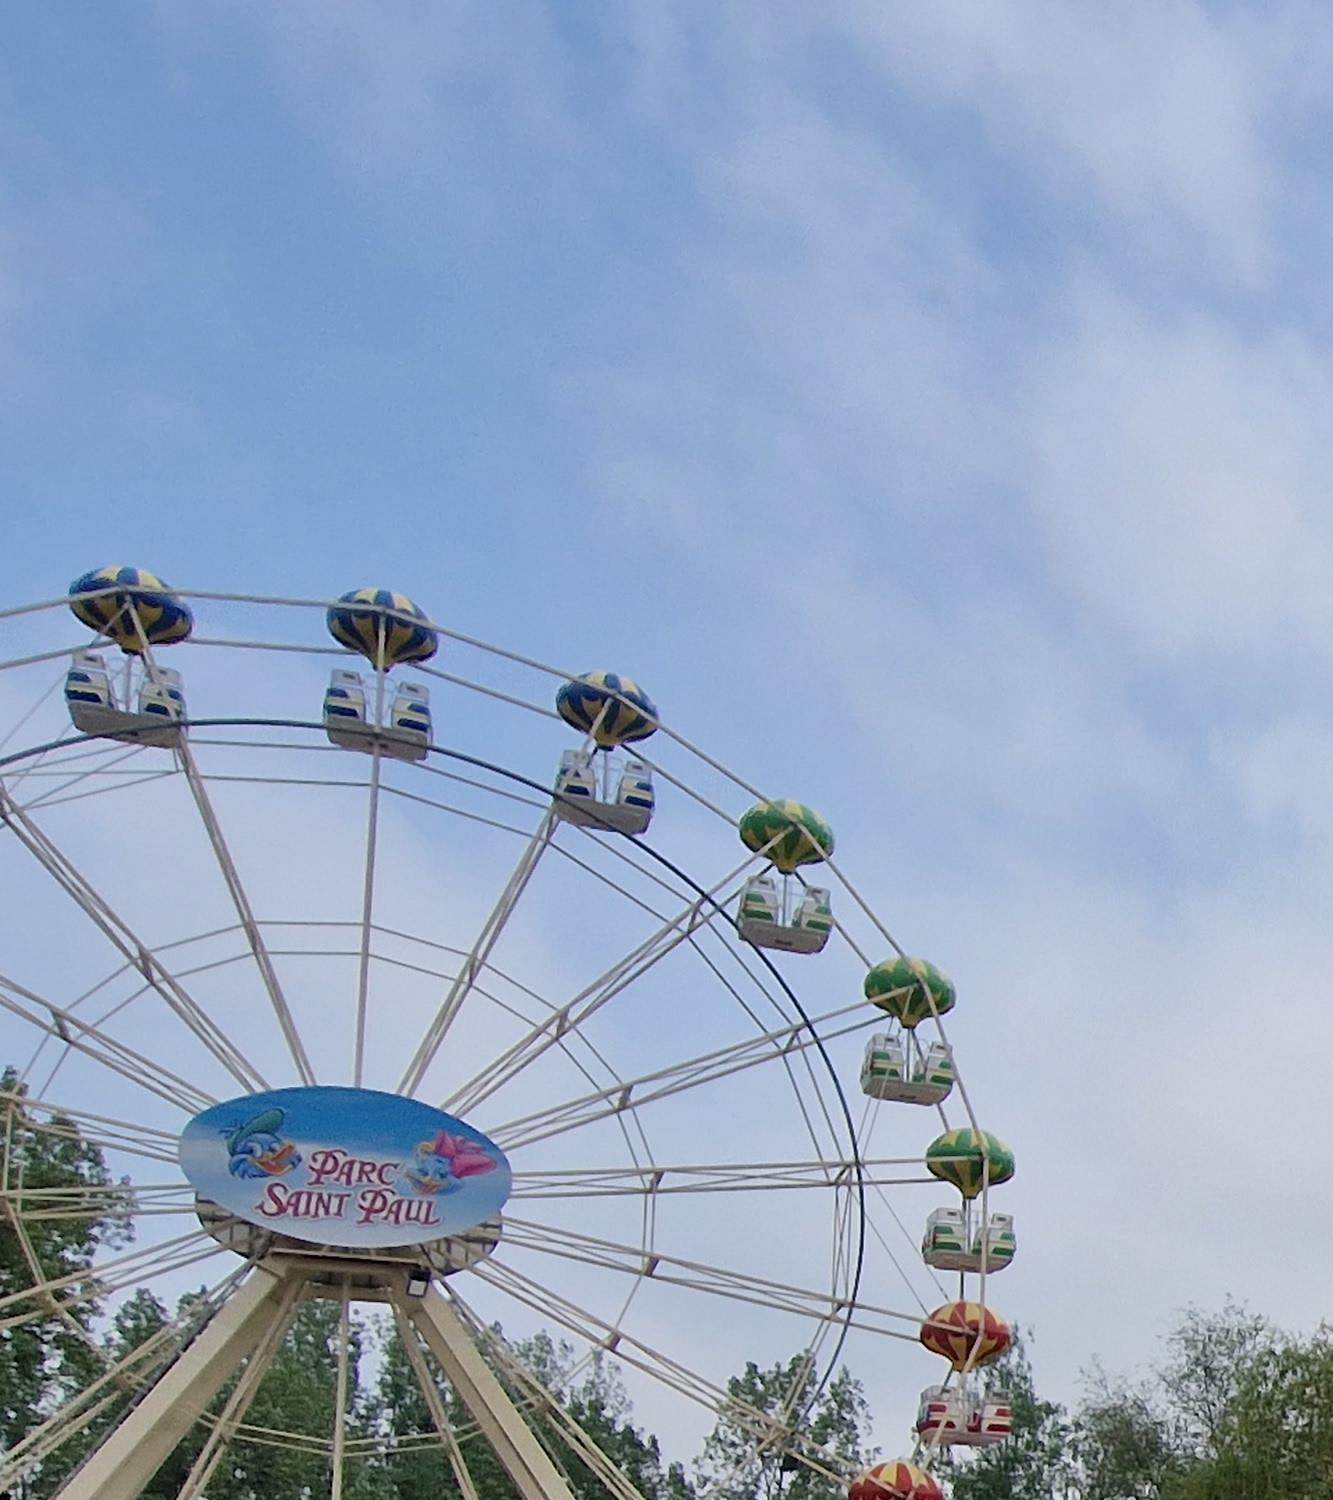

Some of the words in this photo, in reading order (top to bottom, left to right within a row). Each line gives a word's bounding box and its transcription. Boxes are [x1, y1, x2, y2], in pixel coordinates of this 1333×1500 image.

[308, 1149, 399, 1186] PARC
[255, 1183, 352, 1218] SAINT
[357, 1189, 441, 1225] PAUL
